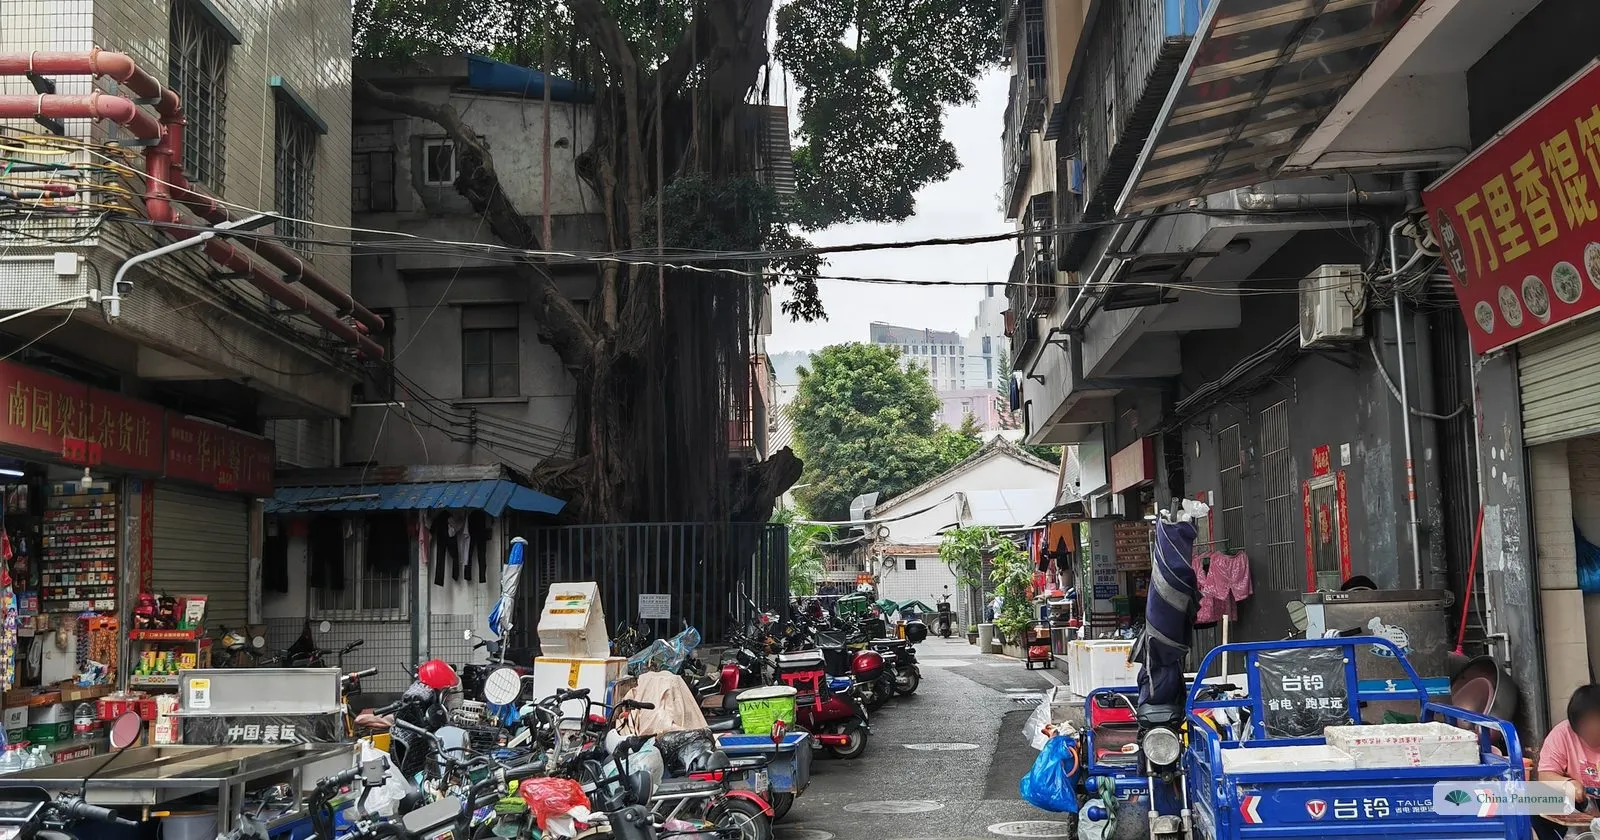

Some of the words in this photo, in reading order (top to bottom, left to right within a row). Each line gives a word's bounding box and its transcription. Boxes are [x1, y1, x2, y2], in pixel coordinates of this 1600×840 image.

[8, 380, 150, 457] 南园梁记杂货店
[1281, 674, 1324, 692] 台铃
[1333, 797, 1390, 820] 台铃
